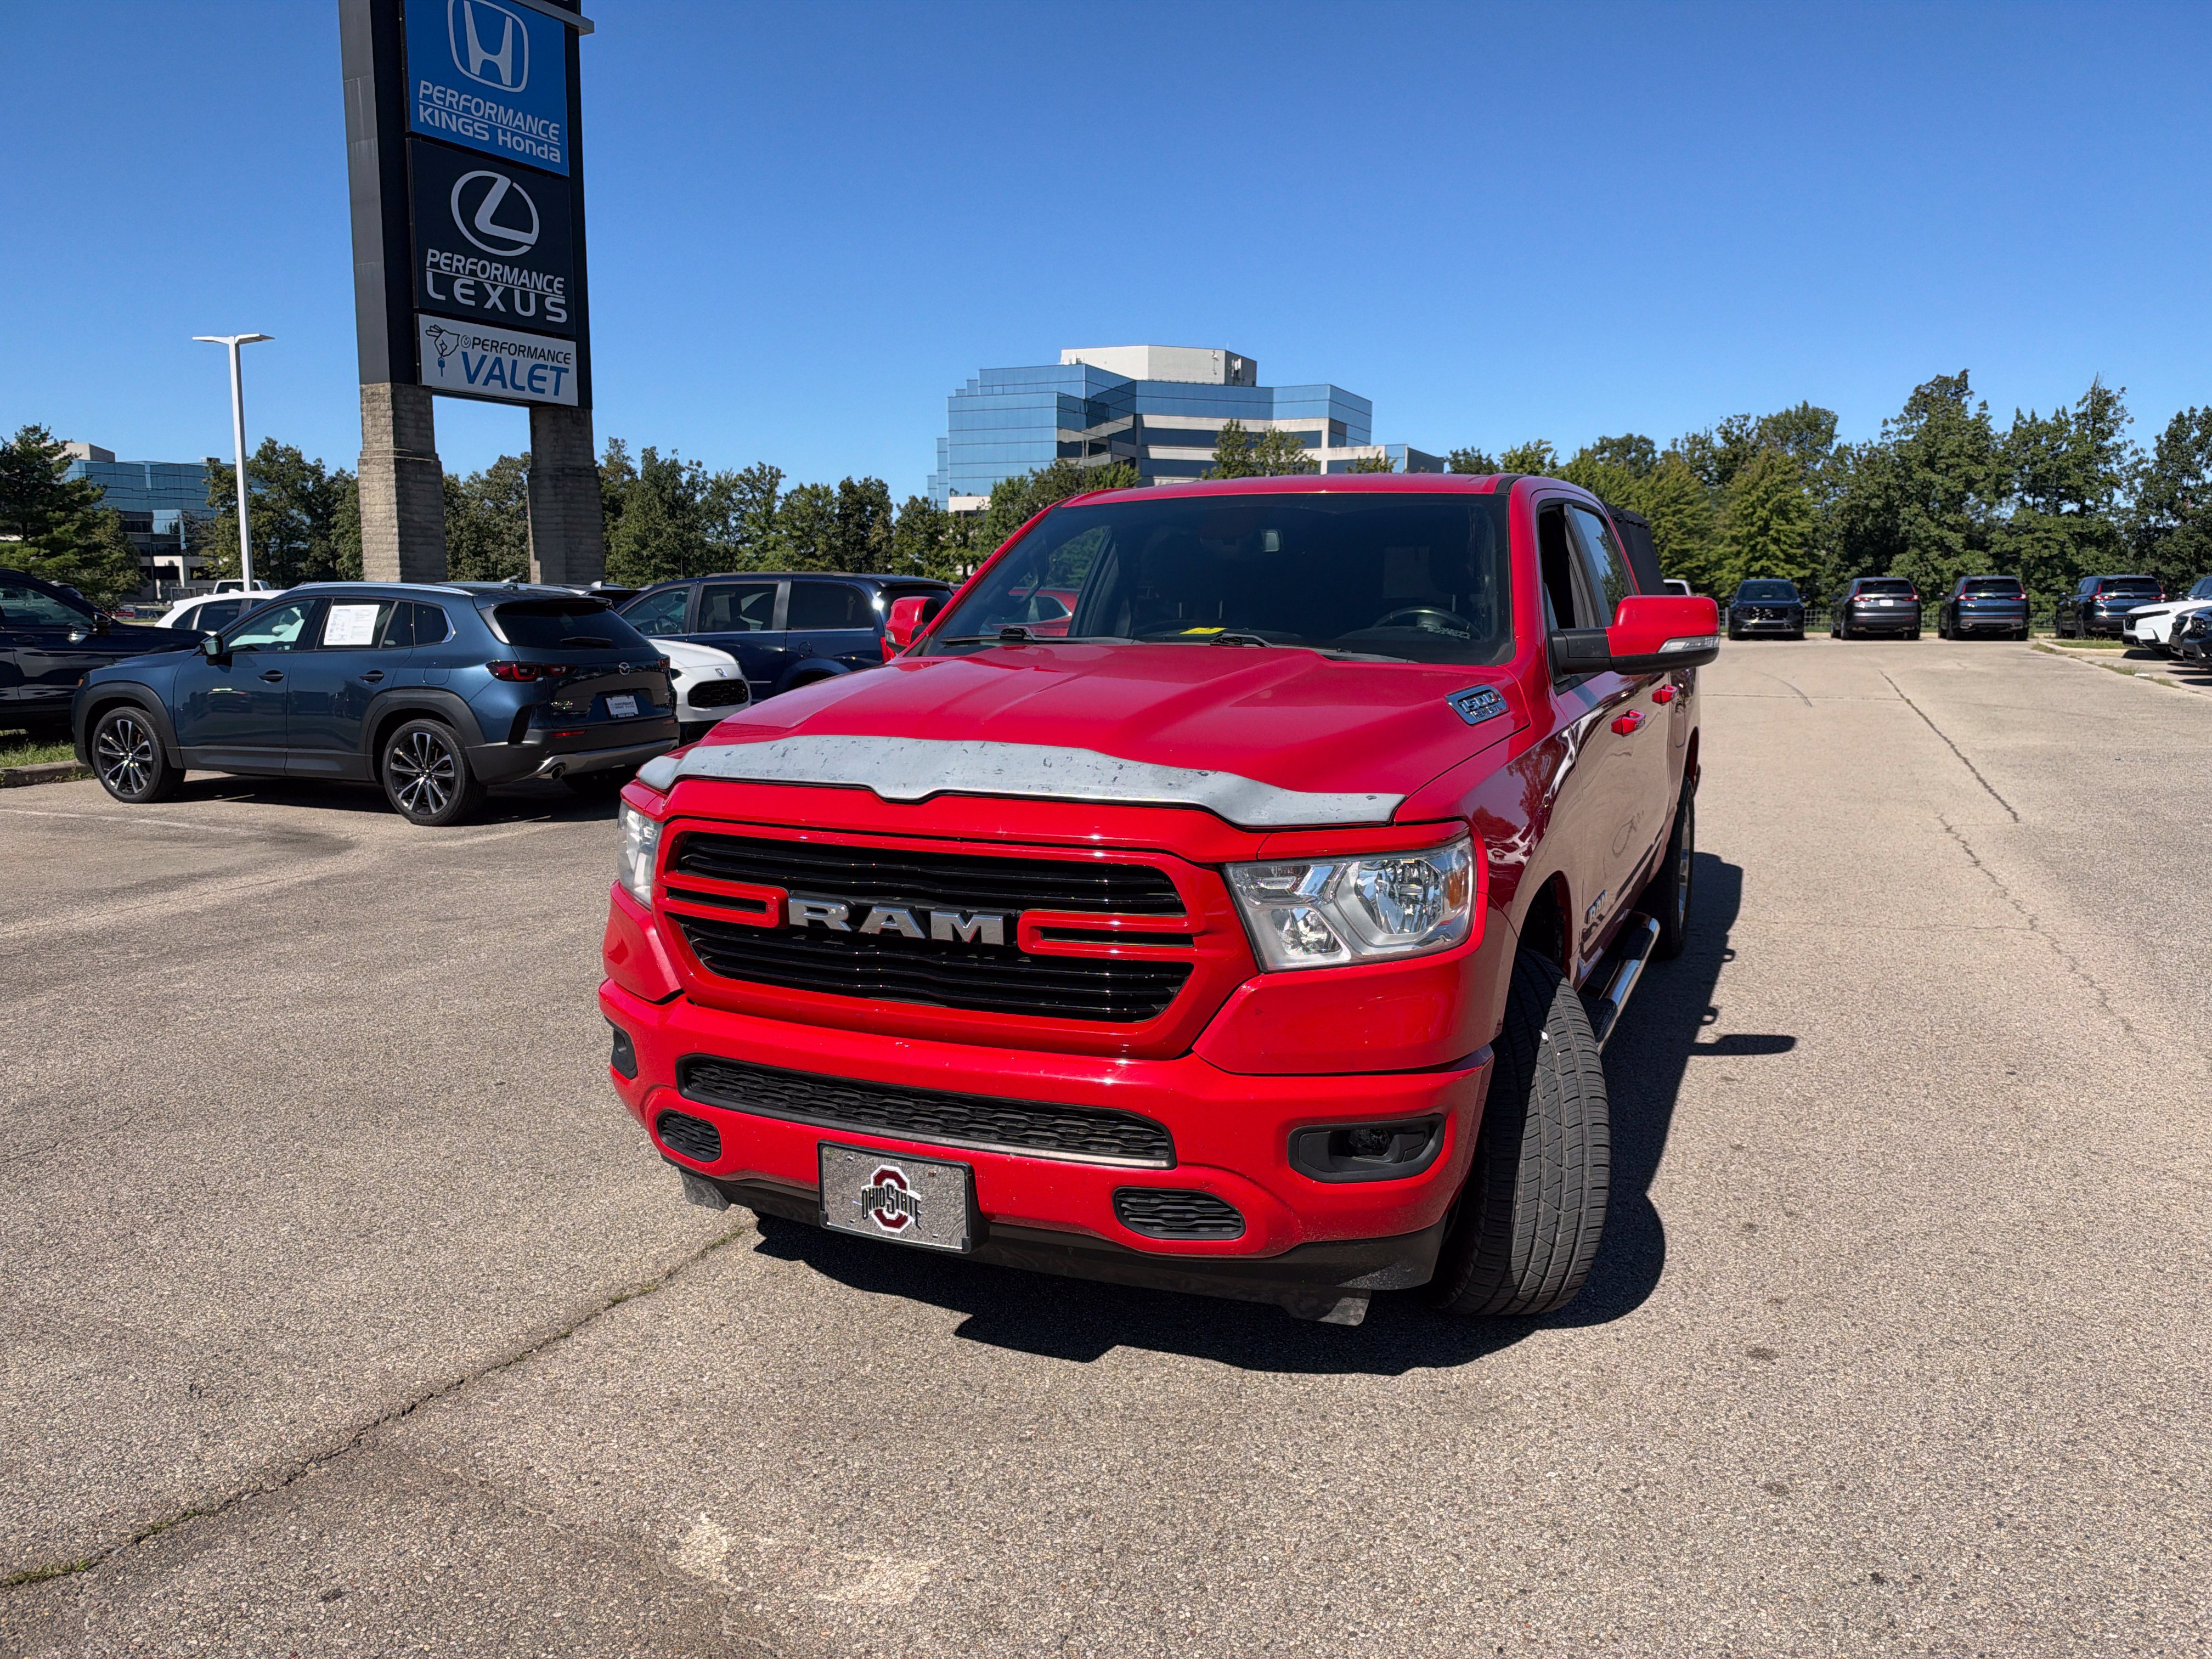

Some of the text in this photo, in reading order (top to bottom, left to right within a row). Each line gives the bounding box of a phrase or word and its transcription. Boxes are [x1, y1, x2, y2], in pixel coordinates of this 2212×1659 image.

[419, 80, 560, 142] PERFORMANCE
[419, 105, 560, 163] KINGS Honda
[426, 249, 565, 295] PERFORMANCE
[426, 270, 567, 323] LEXUS
[472, 337, 571, 365] PERFORMANCE
[461, 352, 569, 397] VALET
[1460, 691, 1497, 712] 1500
[788, 897, 1005, 946] RAM
[861, 1184, 922, 1230] OHIO STATE
